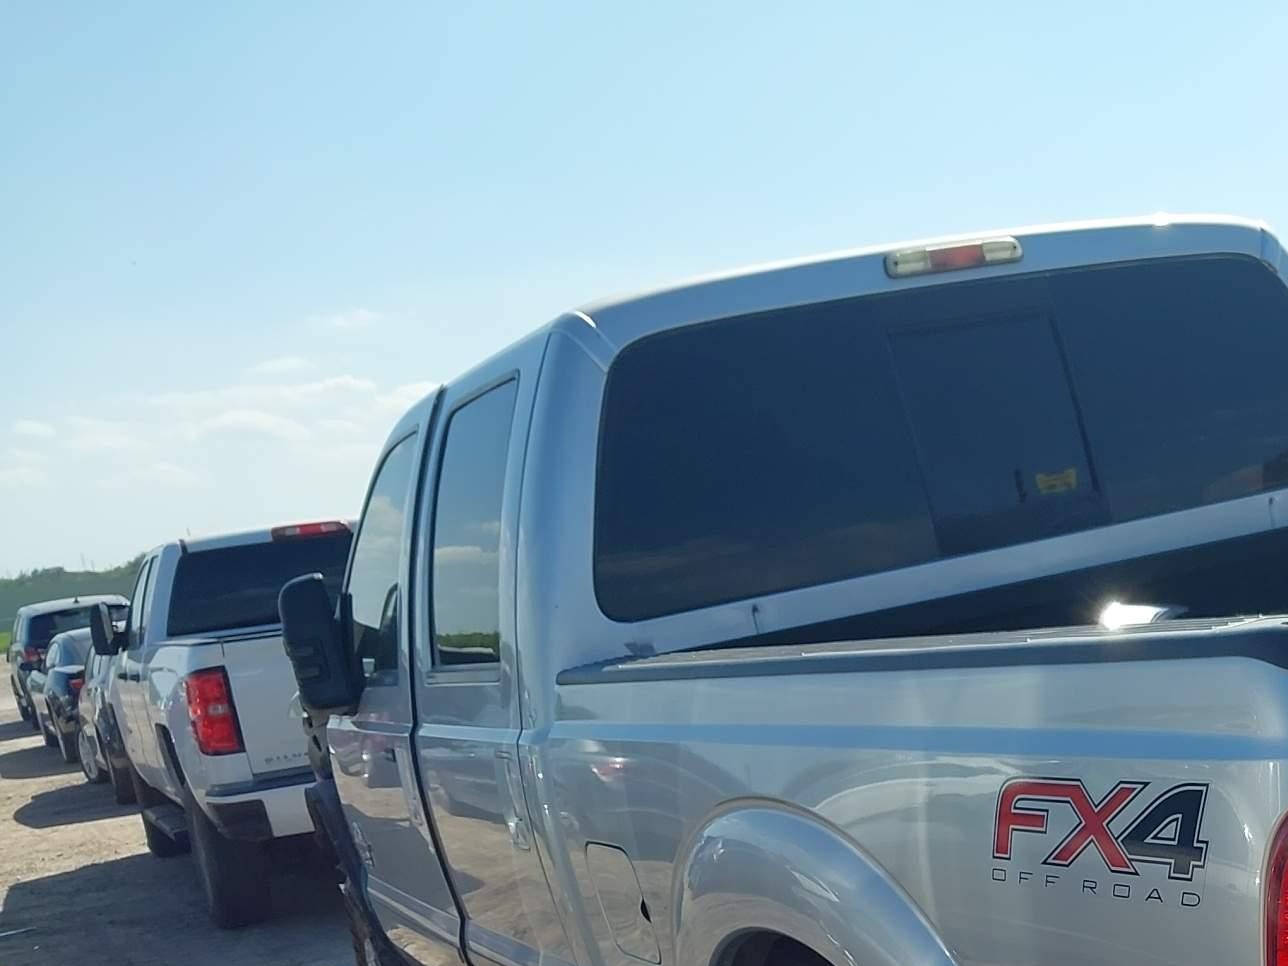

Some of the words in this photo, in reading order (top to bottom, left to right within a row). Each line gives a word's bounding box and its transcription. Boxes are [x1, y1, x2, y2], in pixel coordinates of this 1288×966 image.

[992, 775, 1210, 882] FX4
[991, 867, 1061, 888] OFF
[1081, 878, 1202, 908] ROAD
